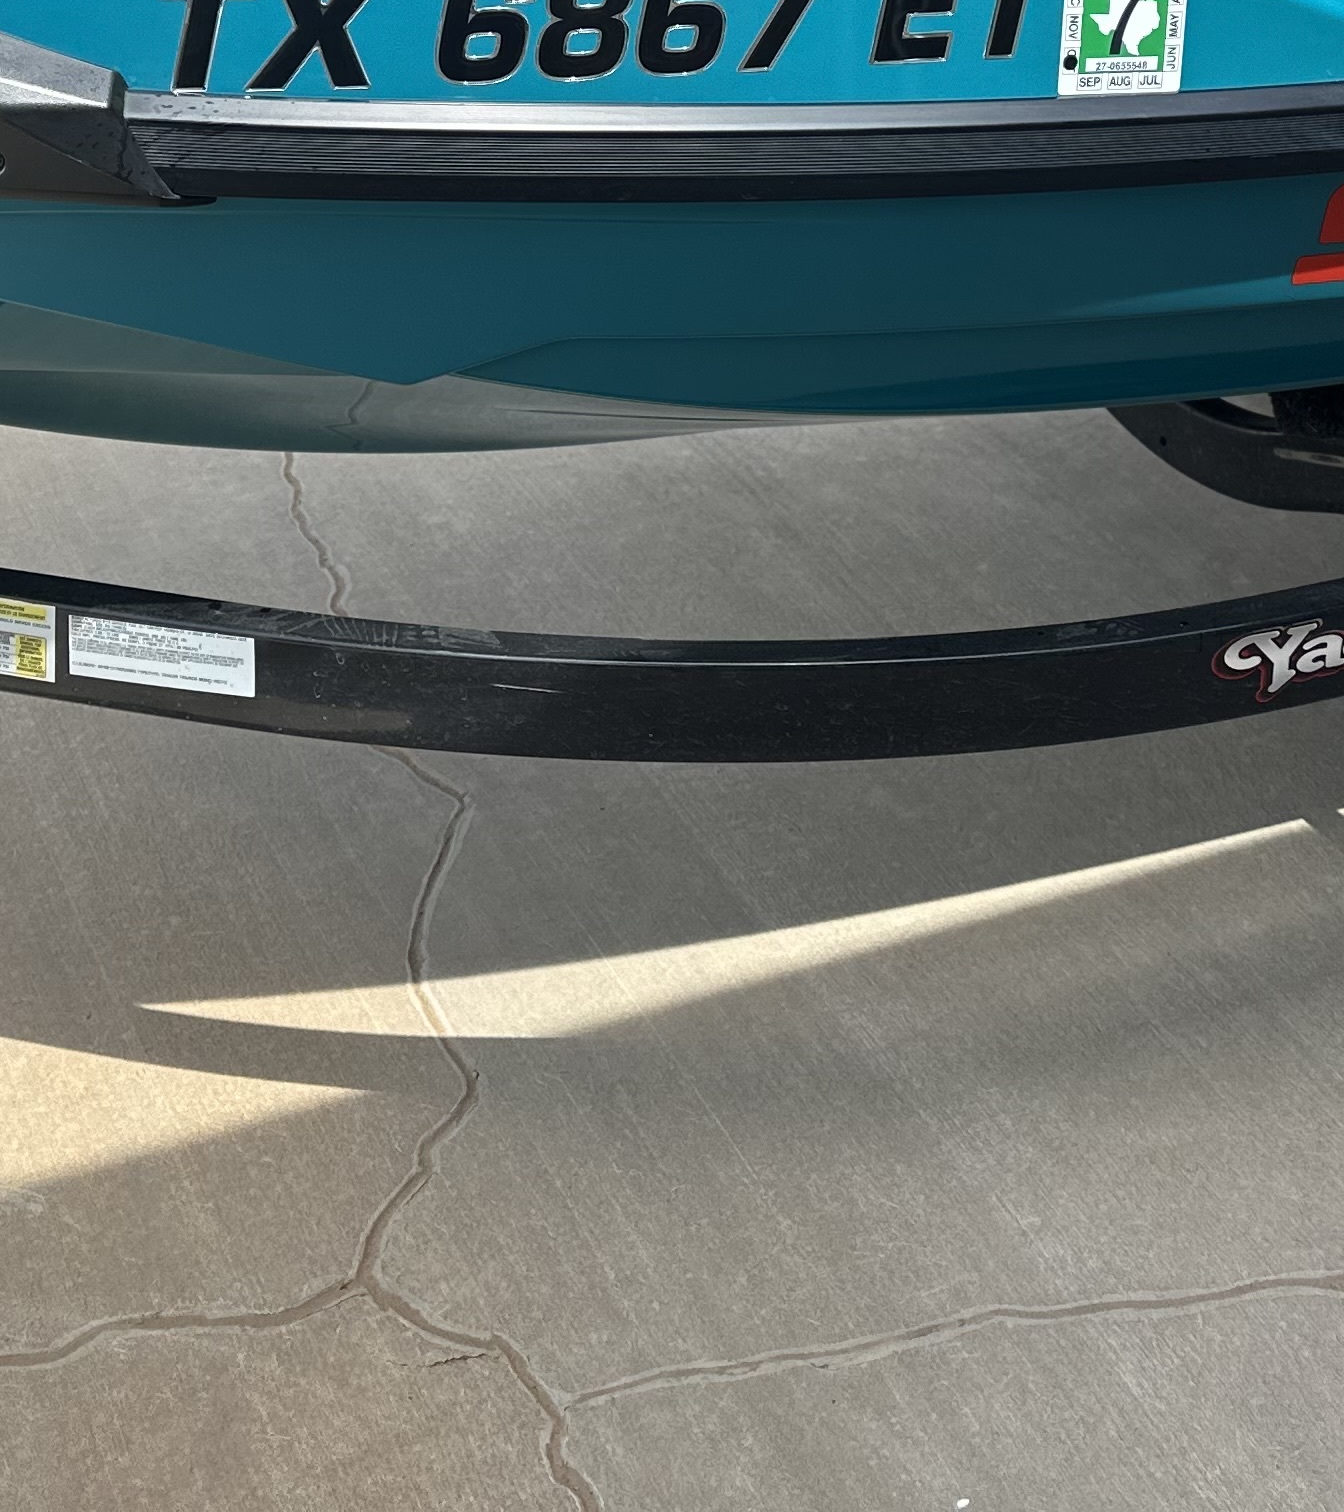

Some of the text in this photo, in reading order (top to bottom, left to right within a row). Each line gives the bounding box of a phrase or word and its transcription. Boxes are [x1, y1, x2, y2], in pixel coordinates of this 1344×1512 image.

[1068, 15, 1080, 39] NOV
[1168, 14, 1180, 38] MAY
[1166, 46, 1177, 70] JUN
[1079, 74, 1161, 88] SEP AUG JUL
